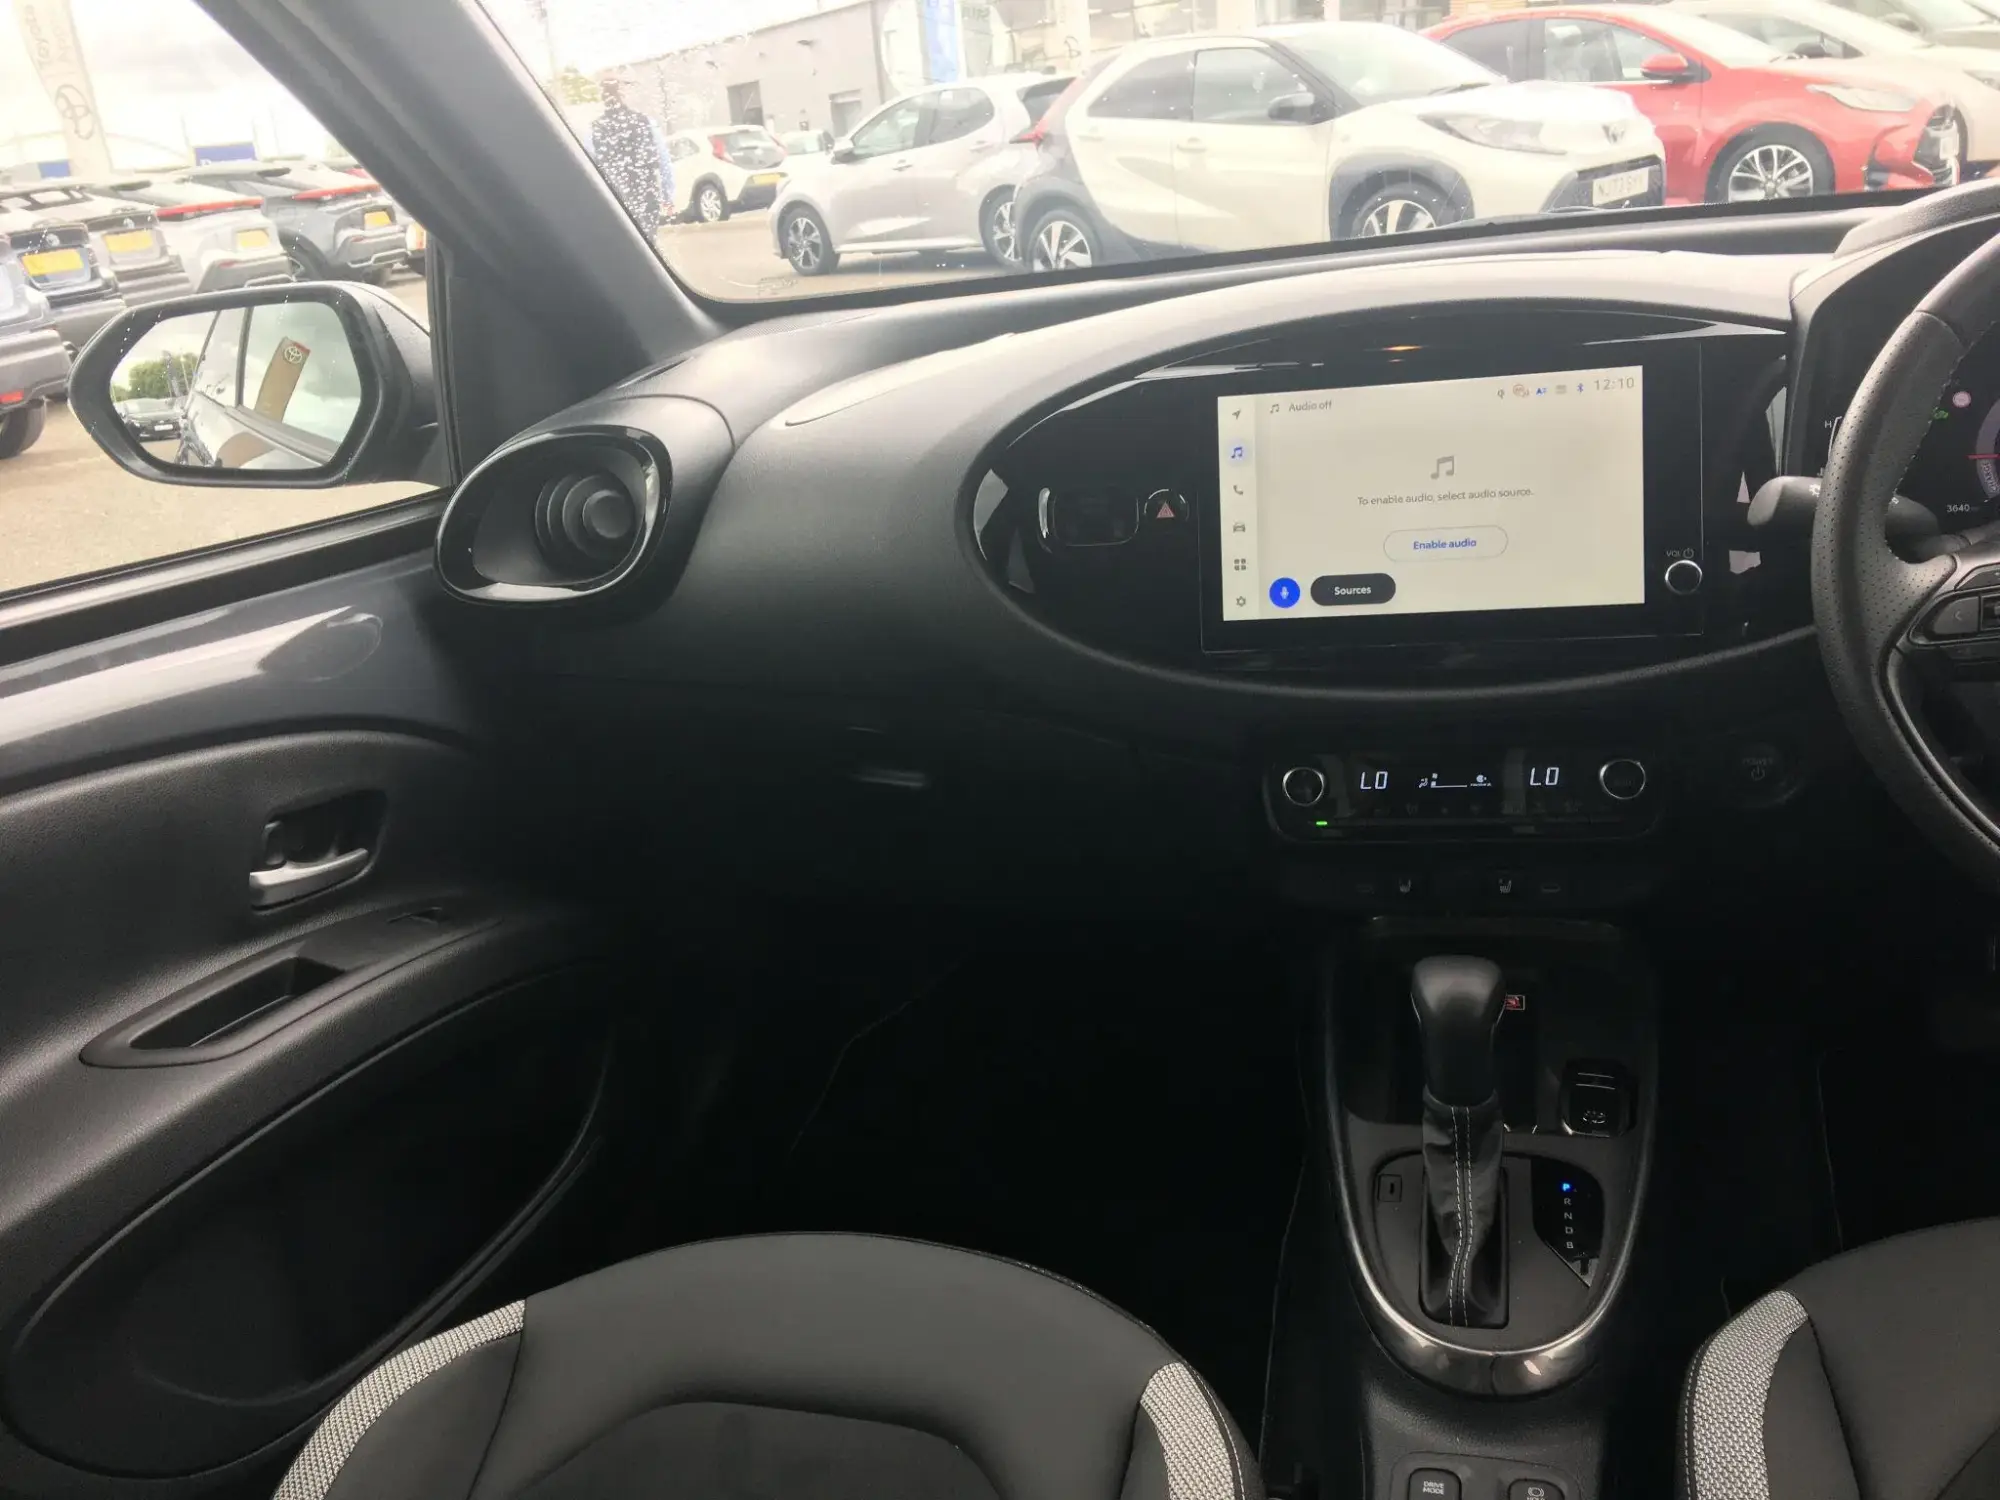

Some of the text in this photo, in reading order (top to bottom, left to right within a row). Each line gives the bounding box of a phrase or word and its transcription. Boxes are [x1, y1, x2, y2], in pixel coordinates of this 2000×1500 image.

[23, 4, 53, 68] Toyota
[1593, 377, 1635, 391] 12:10
[1288, 399, 1332, 412] Audio off
[1824, 420, 1832, 429] H
[1357, 488, 1535, 506] To enable audio, select audio source.
[1413, 537, 1477, 551] Enable audio
[1334, 585, 1372, 596] Sources
[1360, 771, 1388, 790] LO
[1529, 767, 1559, 786] LO
[1562, 1182, 1571, 1191] P
[1563, 1197, 1571, 1205] R
[1564, 1212, 1573, 1220] N
[1565, 1226, 1573, 1234] D
[1423, 1480, 1445, 1489] DRIVE
[1422, 1487, 1445, 1496] MODE
